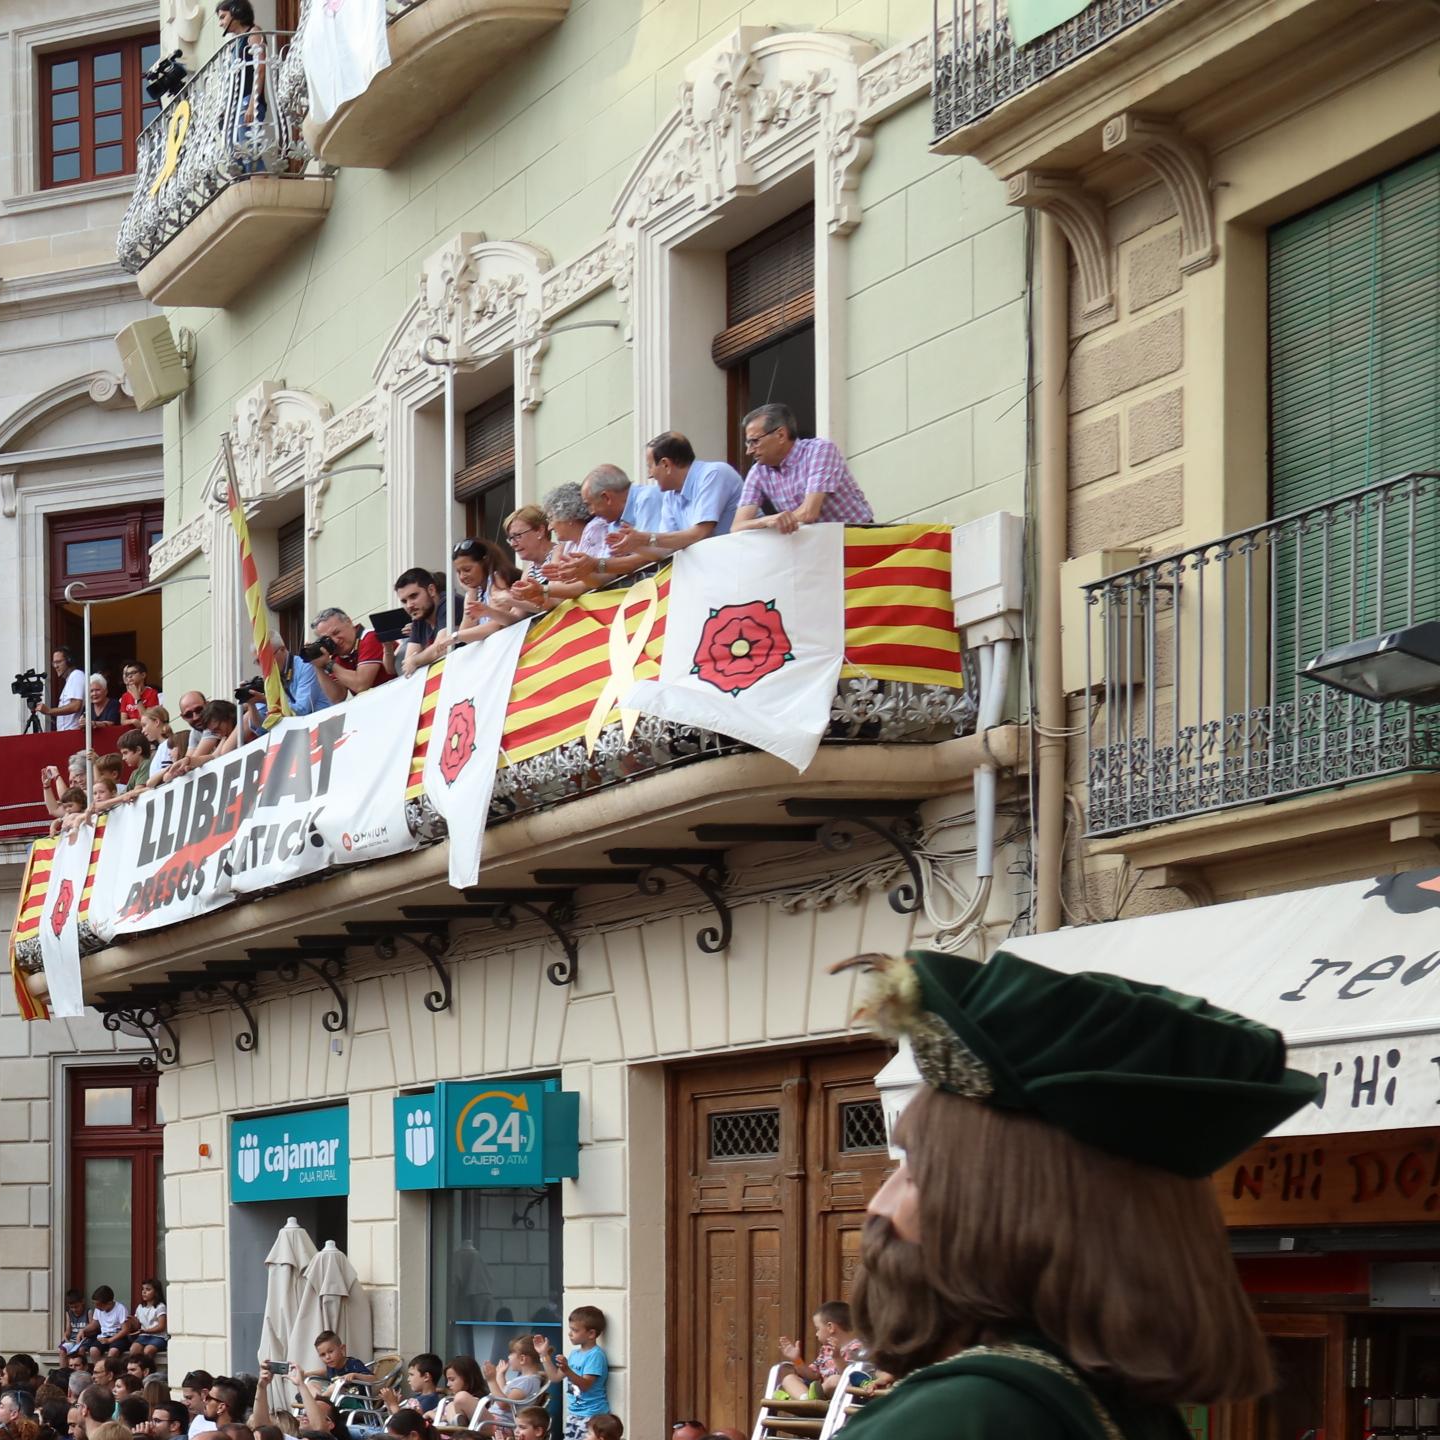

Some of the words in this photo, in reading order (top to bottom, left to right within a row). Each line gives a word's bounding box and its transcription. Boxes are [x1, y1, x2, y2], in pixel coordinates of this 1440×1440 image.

[264, 1134, 340, 1182] cajamar
[463, 1155, 504, 1166] CAJERO
[507, 1155, 528, 1165] ATM
[299, 1172, 315, 1184] CAJA
[317, 1169, 337, 1182] RURAL
